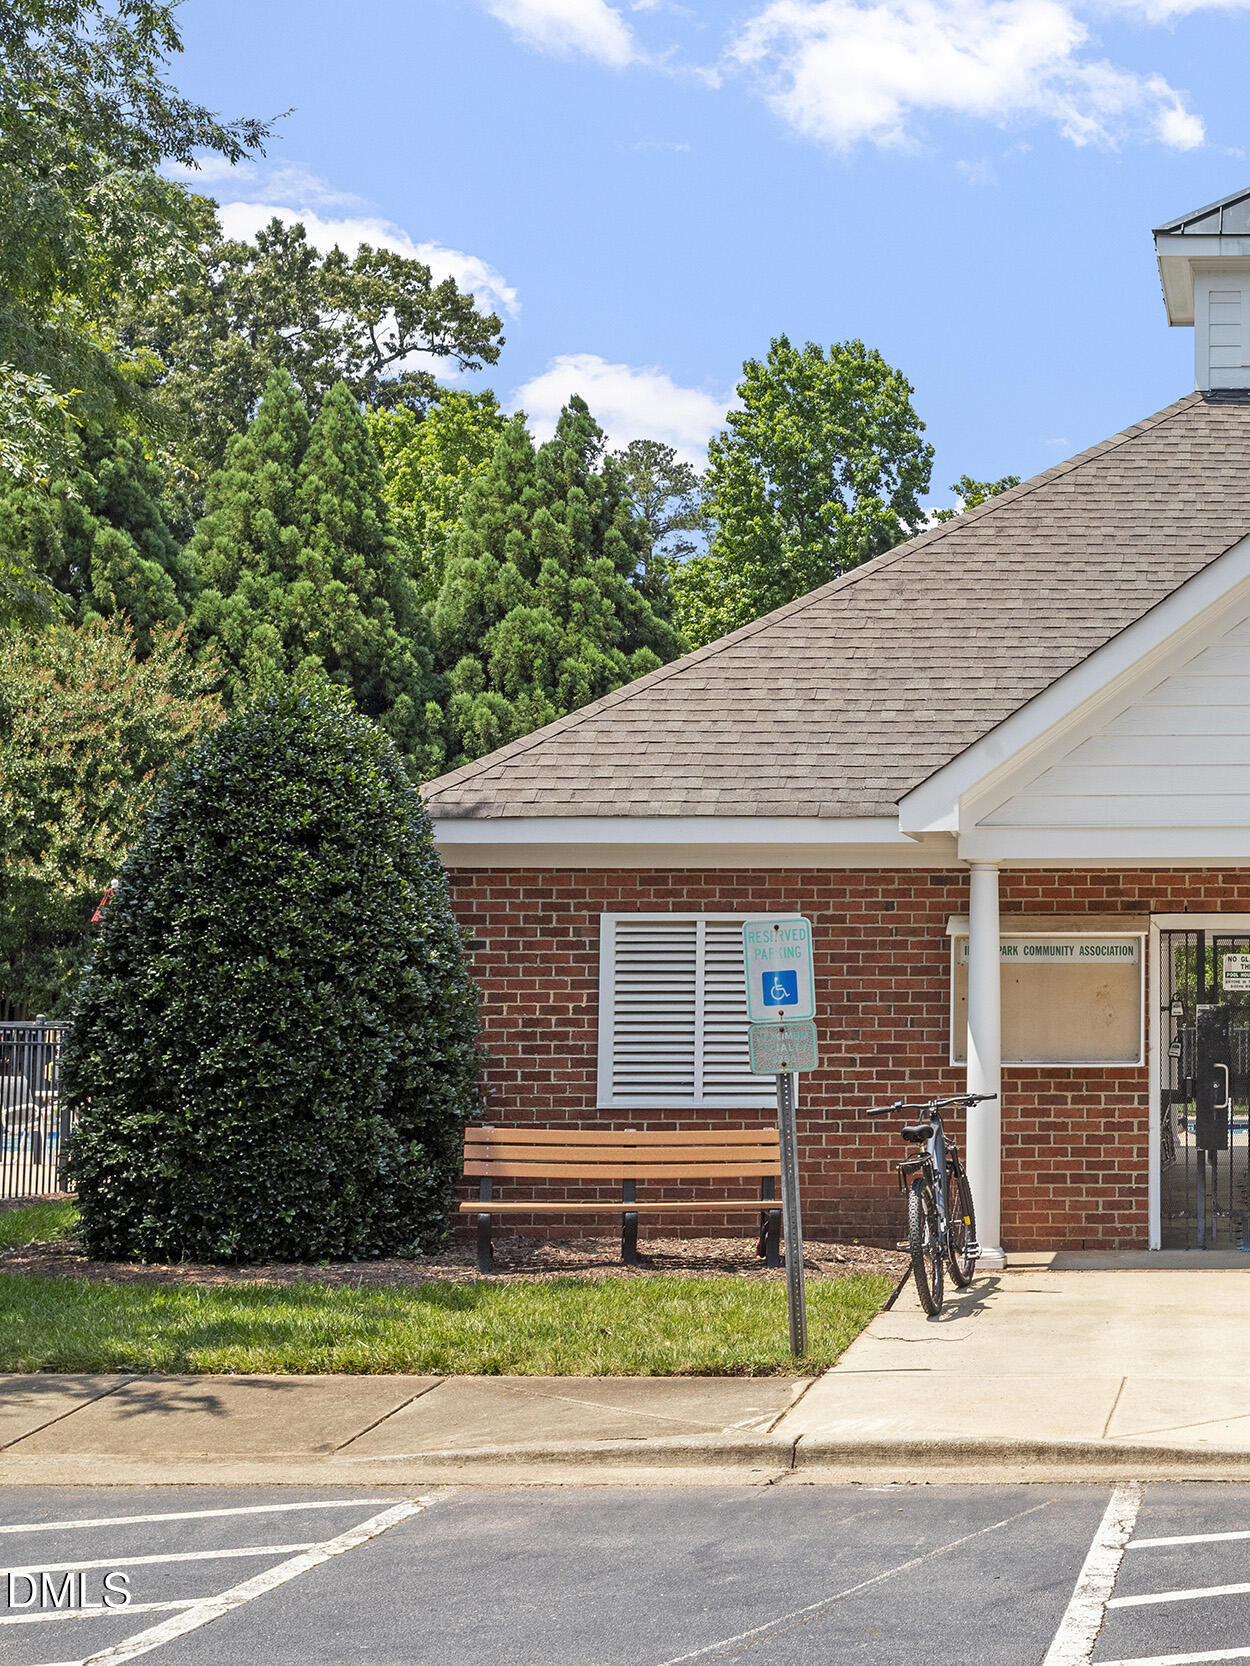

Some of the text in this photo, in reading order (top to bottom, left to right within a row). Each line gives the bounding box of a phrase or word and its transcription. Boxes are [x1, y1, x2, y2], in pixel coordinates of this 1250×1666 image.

[747, 928, 806, 944] RESERVED
[1023, 945, 1075, 956] COMMUNITY
[1079, 945, 1134, 956] ASSOCIATION
